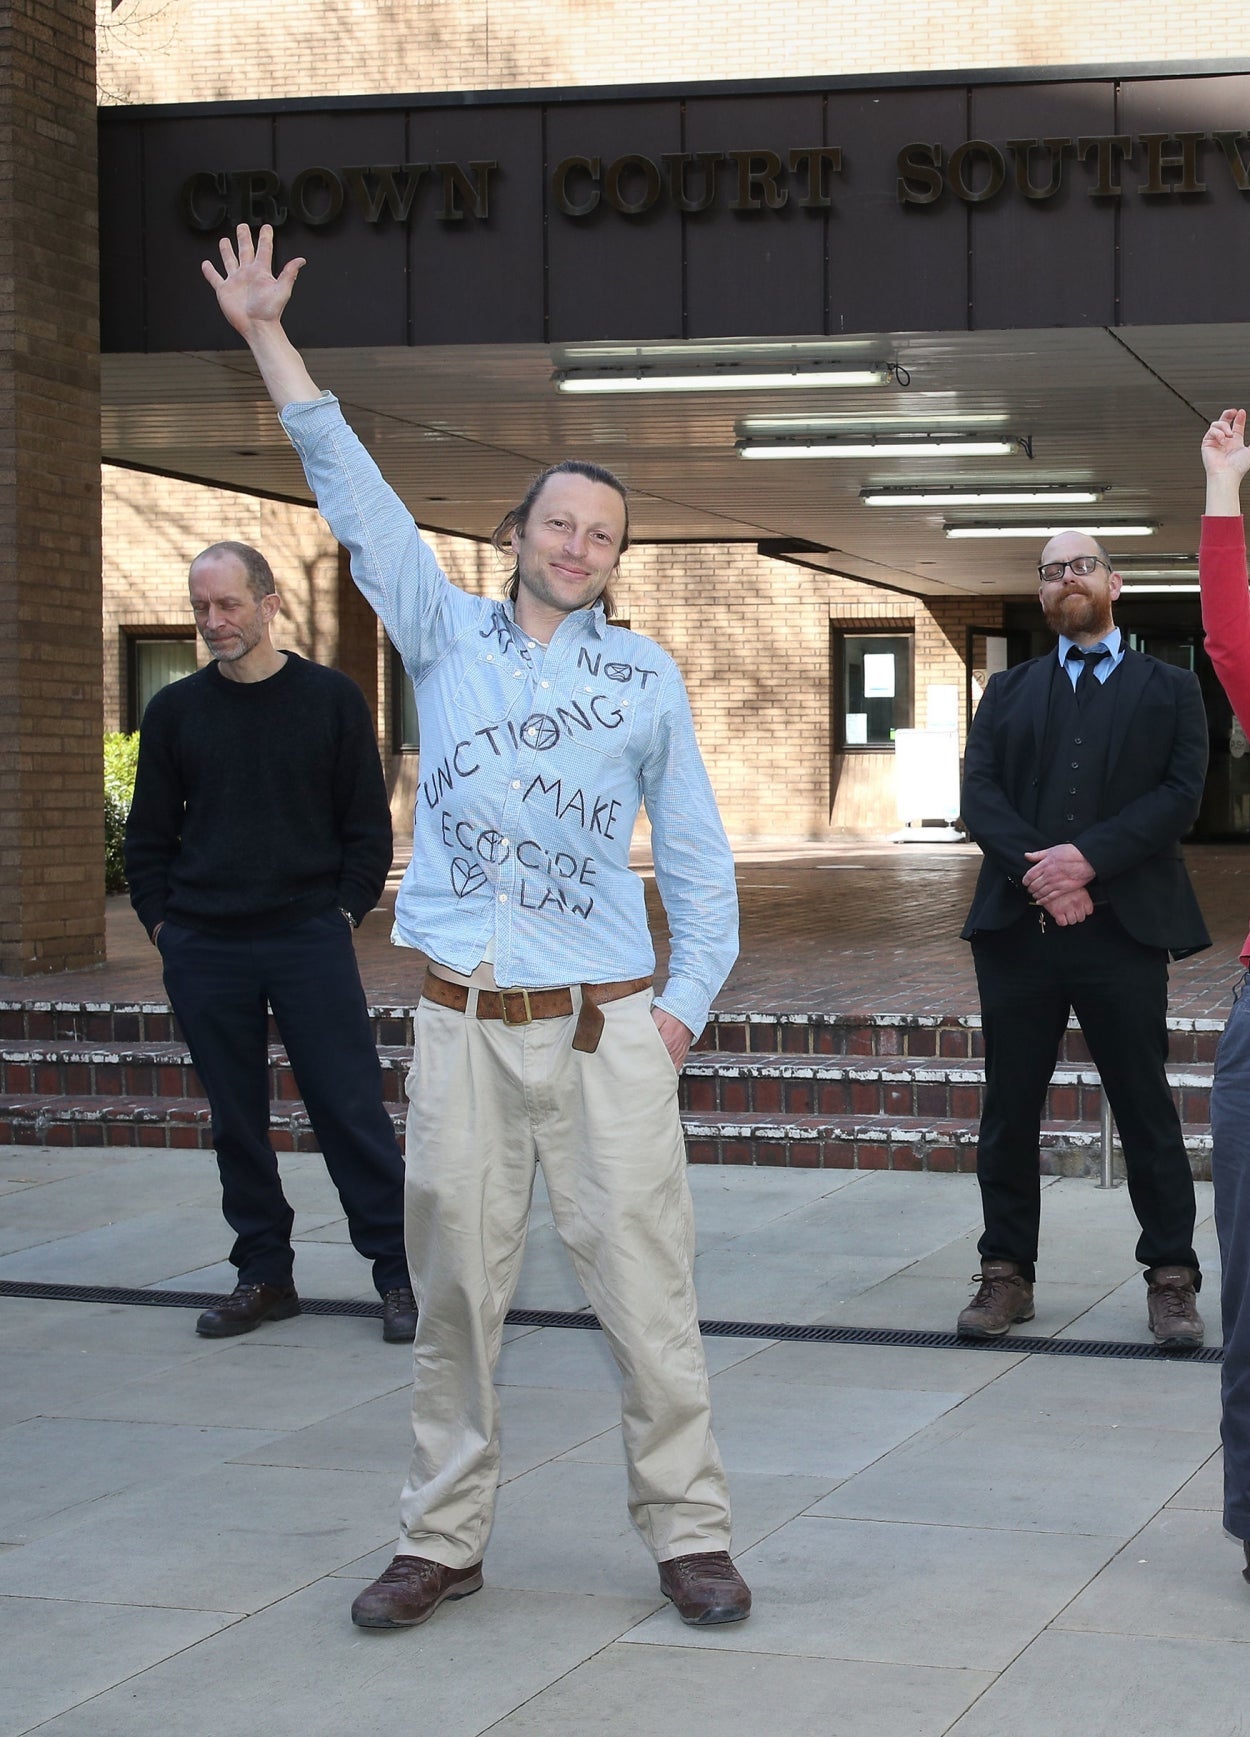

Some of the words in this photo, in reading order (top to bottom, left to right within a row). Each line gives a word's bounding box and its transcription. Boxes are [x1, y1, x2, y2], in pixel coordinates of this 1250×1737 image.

[182, 159, 498, 231] CROWN
[551, 145, 843, 217] COURT
[577, 646, 659, 691] NOT
[522, 774, 622, 840] MAKE
[519, 878, 594, 920] LAW
